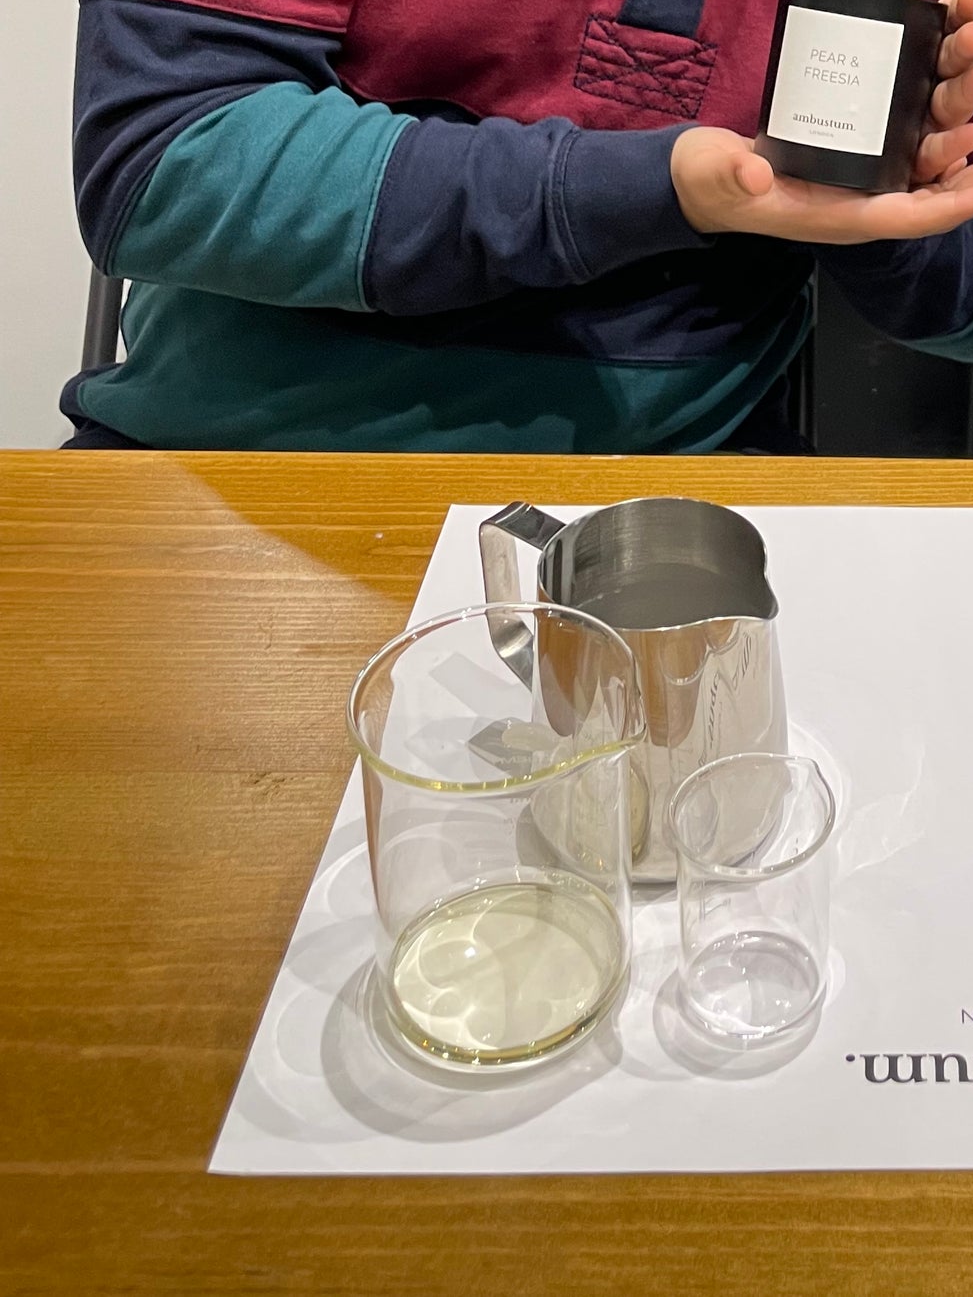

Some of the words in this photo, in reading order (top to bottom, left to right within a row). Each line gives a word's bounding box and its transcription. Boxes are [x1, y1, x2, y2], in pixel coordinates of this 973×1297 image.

[810, 48, 847, 65] PEAR
[849, 55, 860, 67] &
[803, 66, 860, 86] FREESIA
